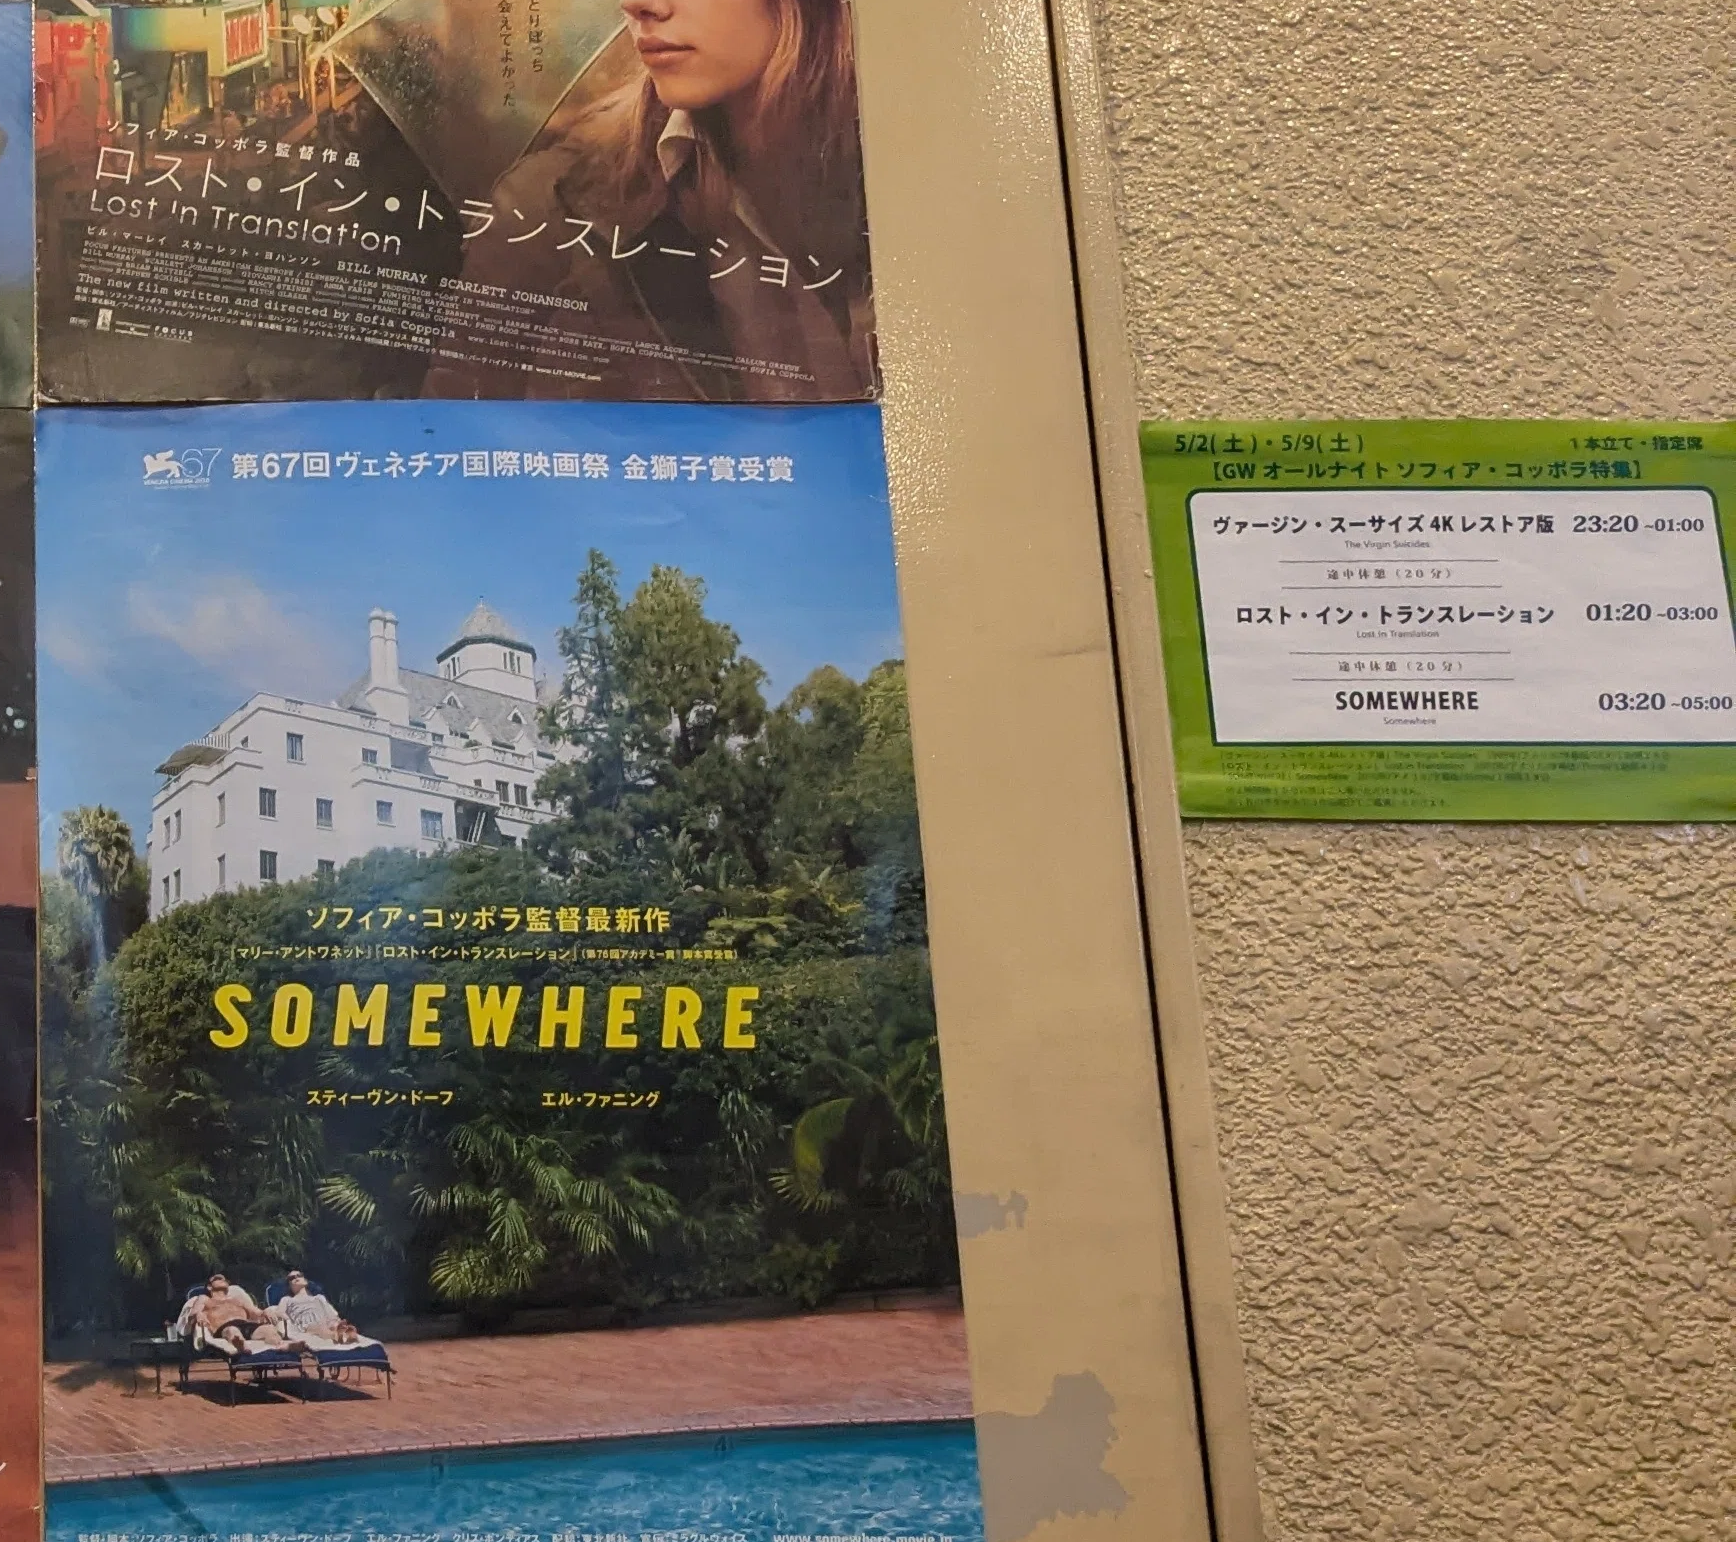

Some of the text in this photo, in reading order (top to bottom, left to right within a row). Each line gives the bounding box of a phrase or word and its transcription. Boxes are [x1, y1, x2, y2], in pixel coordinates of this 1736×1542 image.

[89, 189, 158, 219] Lost
[211, 205, 402, 256] Translation
[95, 146, 843, 290] ロスト・イン・トランスレーション
[336, 260, 589, 312] BILL MURRAY SCARLETT JOHANSSON
[77, 273, 457, 340] The new film written and directed by Sofia Coppola
[231, 450, 796, 483] 第67回ヴェネチア国際映画祭 金獅子賞受賞
[1572, 515, 1639, 534] 23:20
[1235, 605, 1556, 626] ロスト・イン・トランスレーション
[1586, 604, 1652, 622] 01:20
[1335, 690, 1479, 712] SOMEWHERE
[1598, 692, 1666, 712] 03:20
[306, 906, 671, 933] ソフィア・コッポラ監督最新作
[209, 982, 763, 1051] SOMEWHERE
[305, 1088, 660, 1109] スティーヴン・ドーフ エル・ファニング
